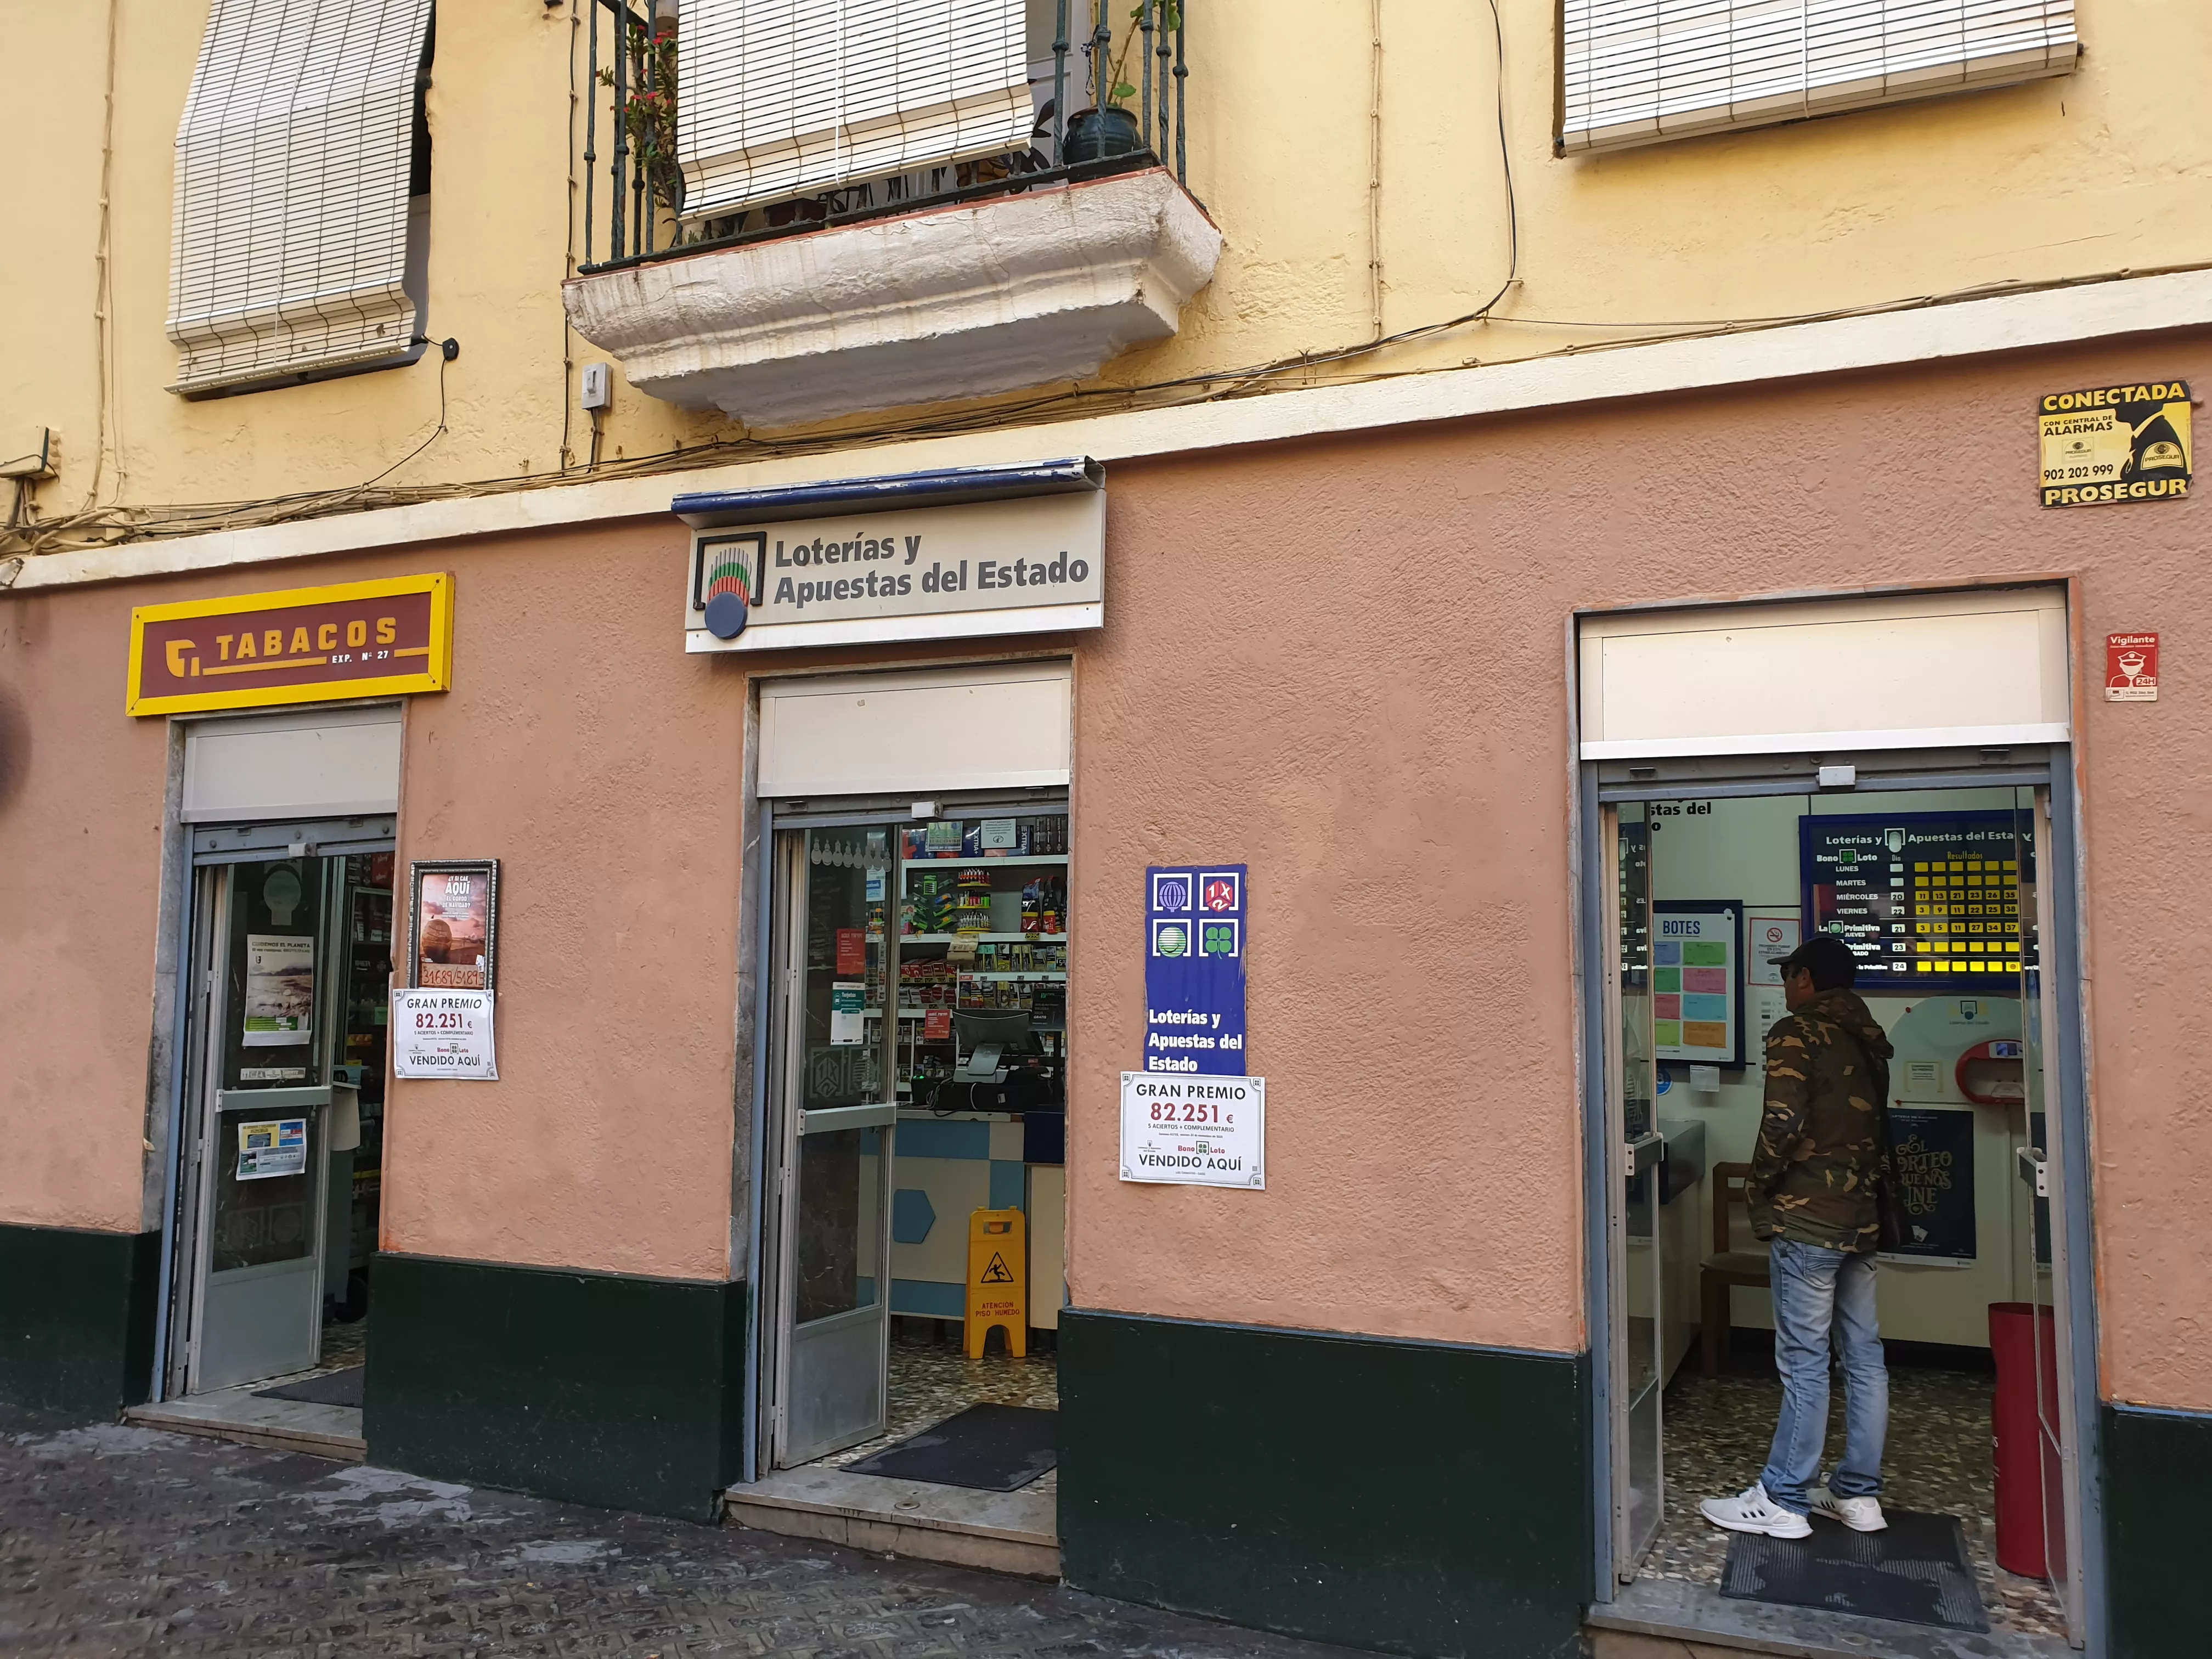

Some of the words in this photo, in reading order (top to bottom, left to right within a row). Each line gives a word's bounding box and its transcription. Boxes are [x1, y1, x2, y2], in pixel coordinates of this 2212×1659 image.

[2044, 383, 2185, 411] CONECTADA
[2064, 416, 2100, 425] CENTRAL
[2044, 421, 2113, 436] ALARMAS
[2044, 469, 2064, 480] 902
[2068, 466, 2089, 478] 202
[2092, 464, 2113, 476] 999
[2045, 478, 2187, 505] PROSEGUR
[775, 532, 895, 568] Loterías
[904, 535, 922, 565] y
[774, 570, 912, 609] Apuestas
[922, 560, 967, 594] del
[978, 552, 1089, 589] Estado
[216, 617, 396, 661] TABACOS
[2111, 636, 2155, 645] Vigilante
[332, 654, 352, 663] EXP.
[377, 650, 388, 659] 27
[1686, 802, 1711, 815] del
[1826, 835, 1872, 844] Loterías
[1876, 837, 1882, 845] y
[1908, 833, 1962, 844] Apuestas
[1966, 832, 1984, 840] del
[1948, 850, 1983, 860] Resultados
[445, 881, 470, 895] AQUÍ
[1663, 920, 1700, 934] BOTES
[407, 998, 437, 1008] GRAN
[442, 998, 482, 1008] PREMIO
[416, 1013, 462, 1028] 82.251
[1149, 1009, 1207, 1024] Loterías
[1212, 1013, 1221, 1029] y
[1149, 1032, 1215, 1051] Apuestas
[1220, 1034, 1242, 1049] del
[410, 1056, 454, 1065] VENDIDO
[458, 1054, 480, 1066] AQUÍ
[1149, 1056, 1198, 1071] Estado
[1136, 1084, 1180, 1097] GRAN
[1188, 1086, 1246, 1099] PREMIO
[1150, 1102, 1218, 1123] 82.251
[1226, 1114, 1233, 1124] €
[1139, 1154, 1201, 1167] VENDIDO
[1207, 1156, 1242, 1171] AQUÍ
